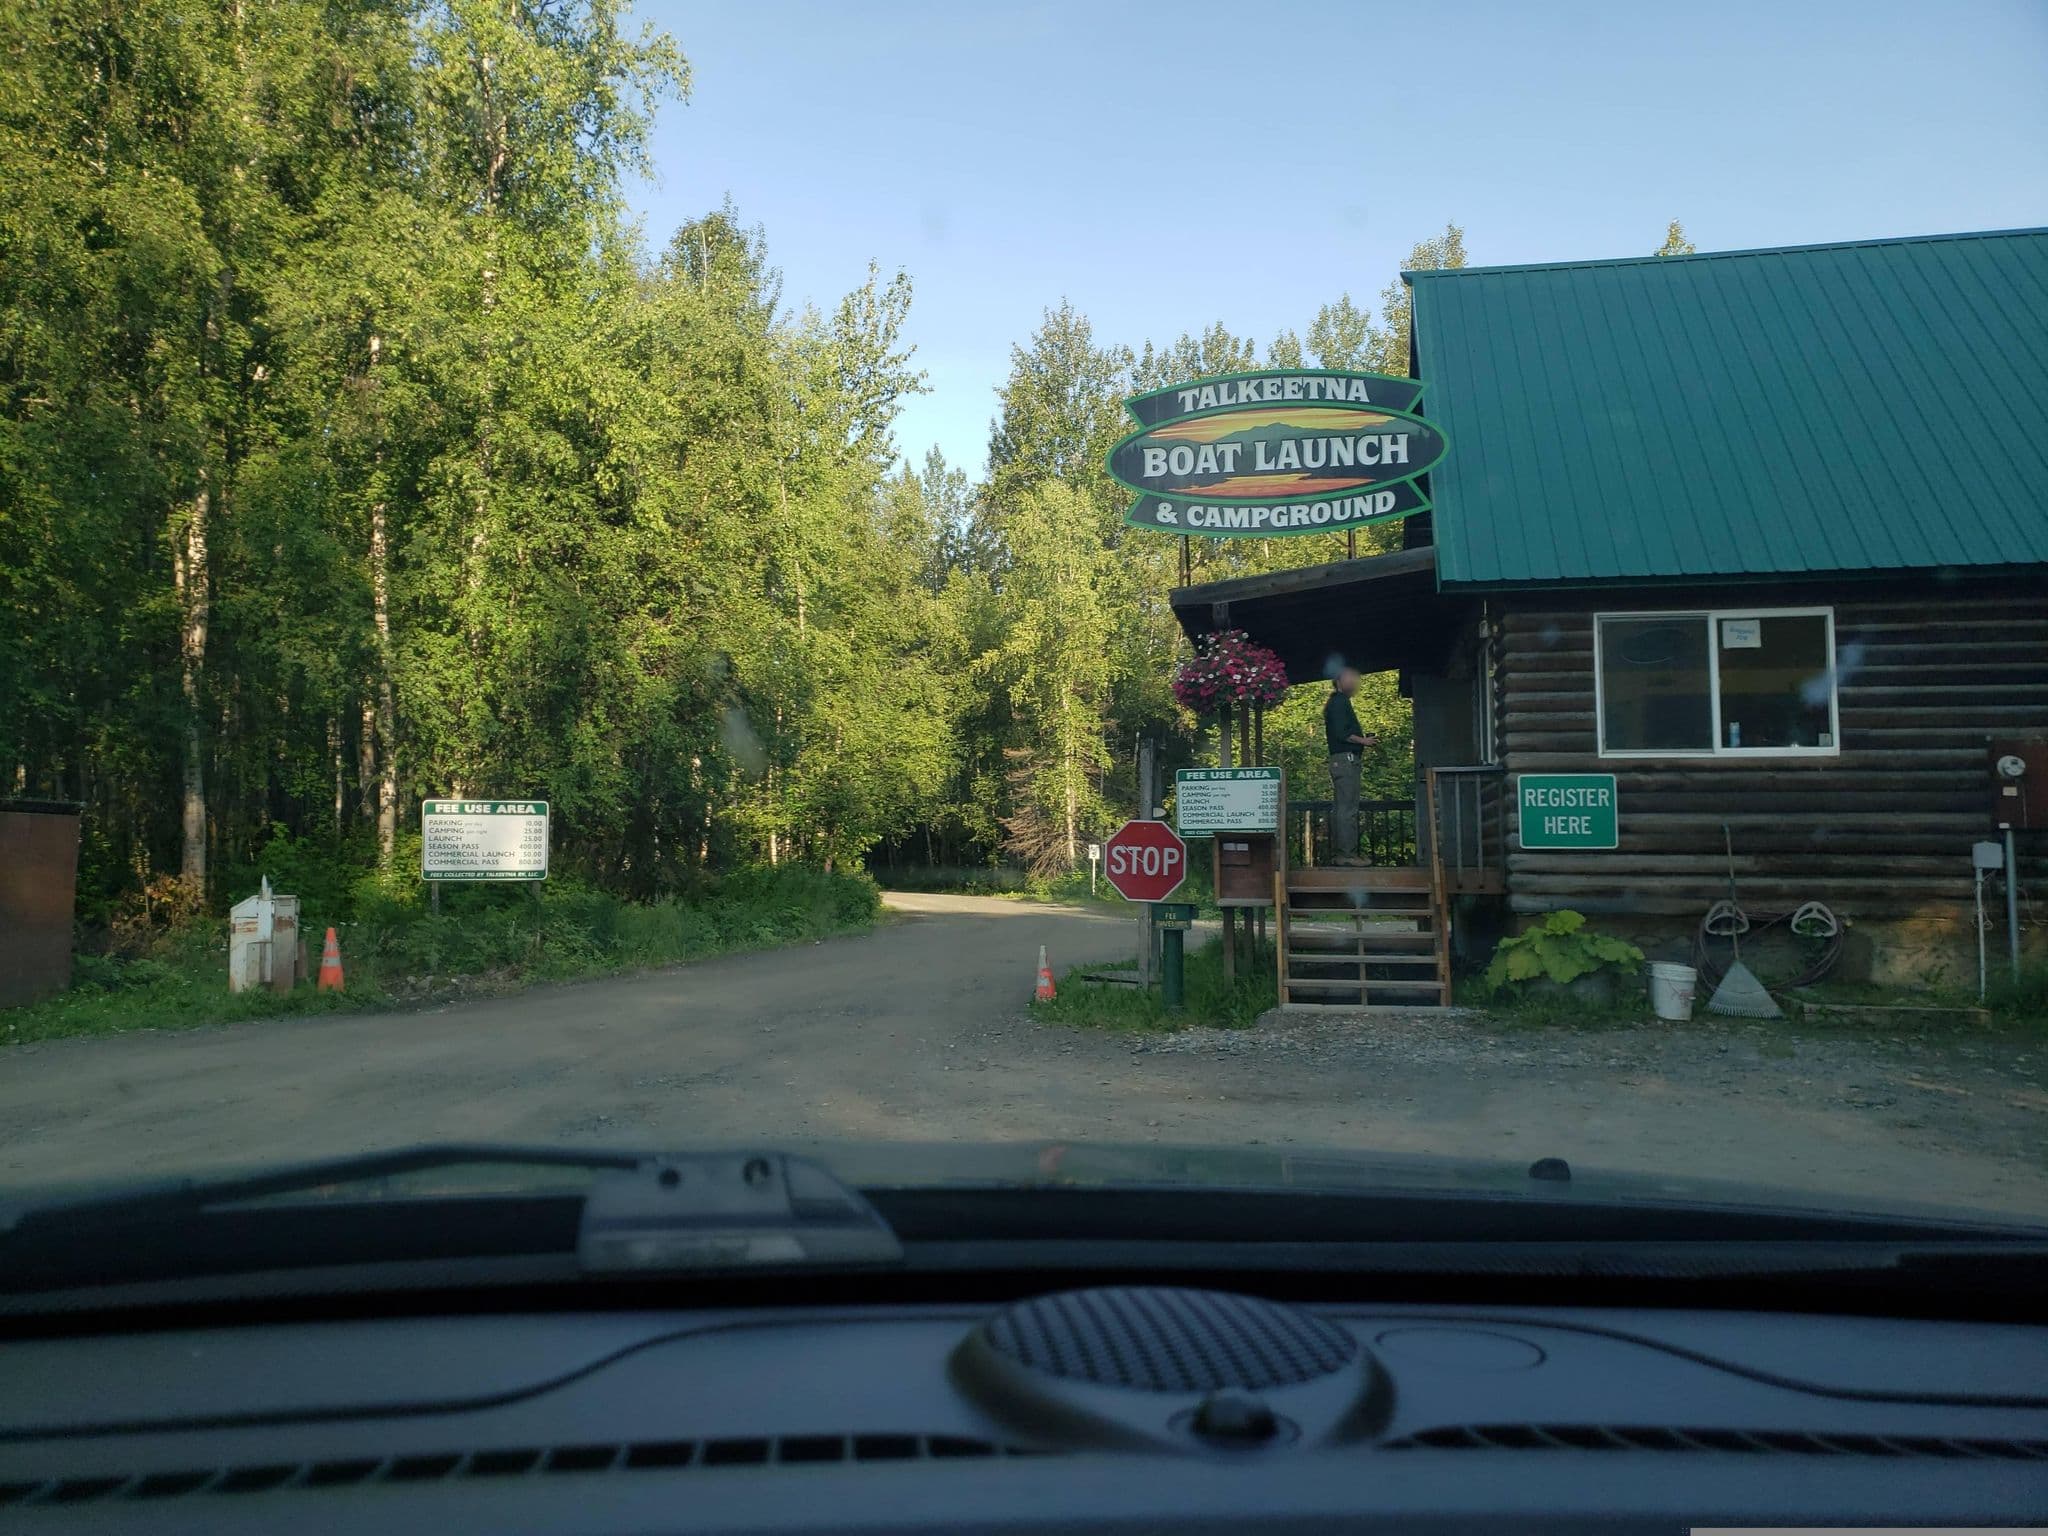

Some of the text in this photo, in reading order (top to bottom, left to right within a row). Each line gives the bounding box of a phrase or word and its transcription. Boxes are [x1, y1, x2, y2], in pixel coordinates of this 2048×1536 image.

[1178, 376, 1370, 413] TALKEETNA
[1143, 433, 1409, 477] BOAT LAUNCH
[1156, 490, 1396, 528] & CAMPGROUND
[1186, 770, 1271, 780] FEE USE AREA
[435, 803, 537, 814] FEE USE AREA
[1525, 788, 1610, 807] REGISTER
[1544, 816, 1592, 835] HERE
[1110, 845, 1180, 876] STOP
